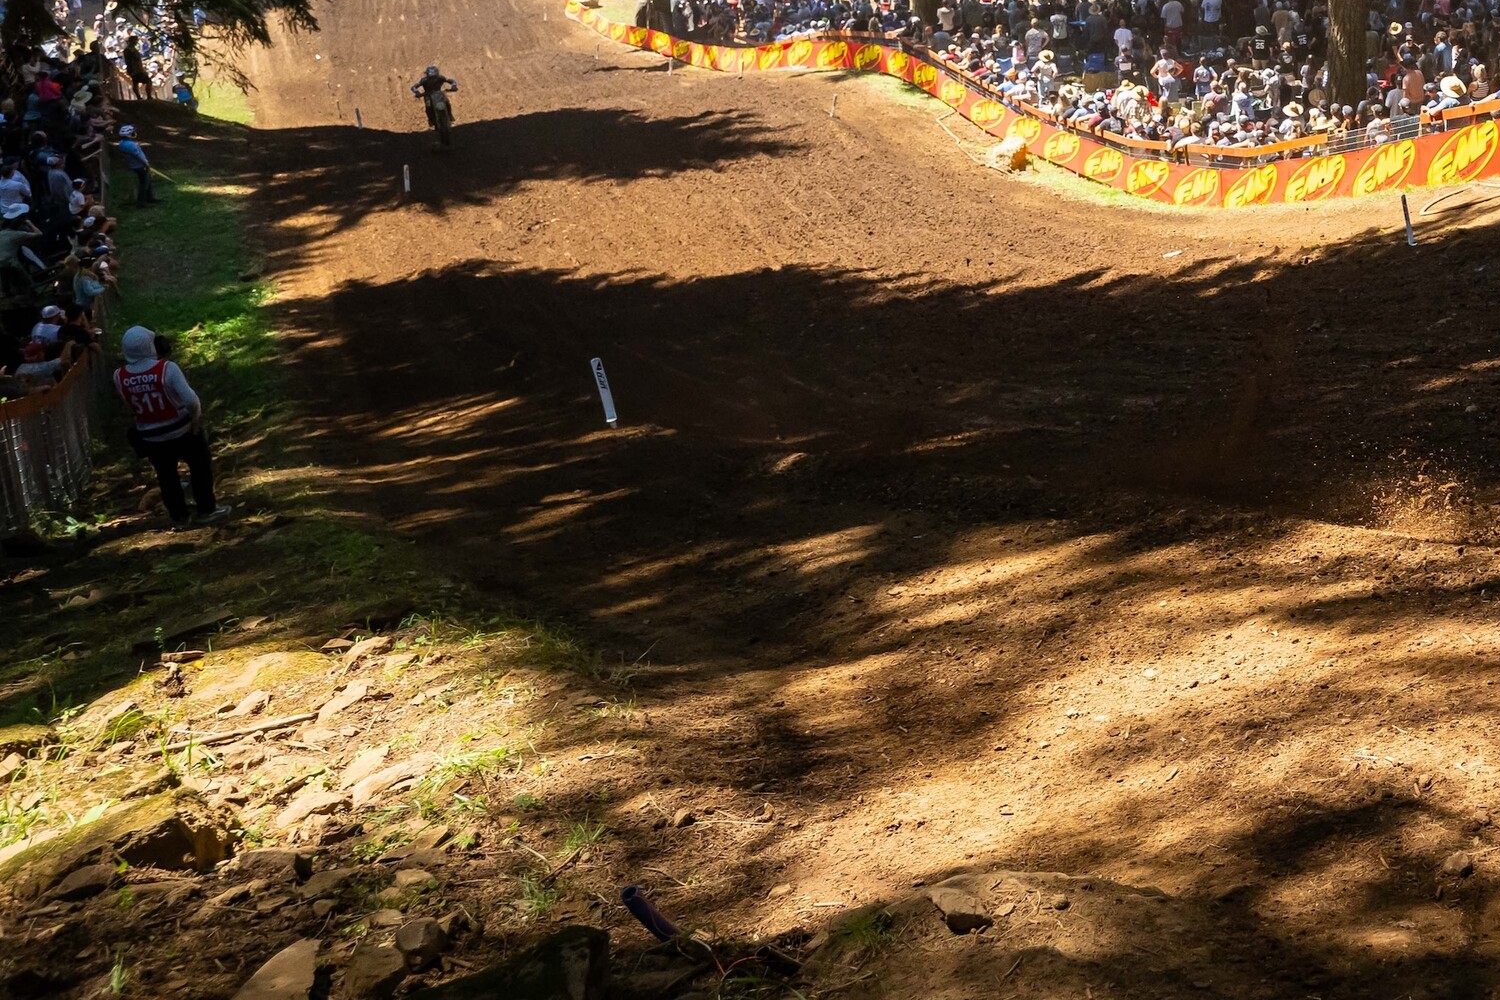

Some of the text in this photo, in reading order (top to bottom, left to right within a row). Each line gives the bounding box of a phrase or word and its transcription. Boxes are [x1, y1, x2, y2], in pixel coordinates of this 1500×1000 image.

[855, 44, 882, 70] FMF
[1255, 42, 1265, 50] 25
[888, 51, 910, 71] FMF
[915, 64, 938, 85] FMF
[941, 81, 967, 102] FMF
[971, 100, 1006, 123] FMF
[1045, 133, 1081, 160] FMF
[1430, 121, 1497, 186] FMF
[1086, 150, 1123, 177] FMF
[1129, 161, 1168, 192] FMF
[1357, 139, 1413, 197] FMF
[1178, 169, 1219, 207] FMF
[1227, 163, 1276, 208] FMF
[1287, 154, 1343, 202] FMF
[123, 374, 158, 386] OCTOPI
